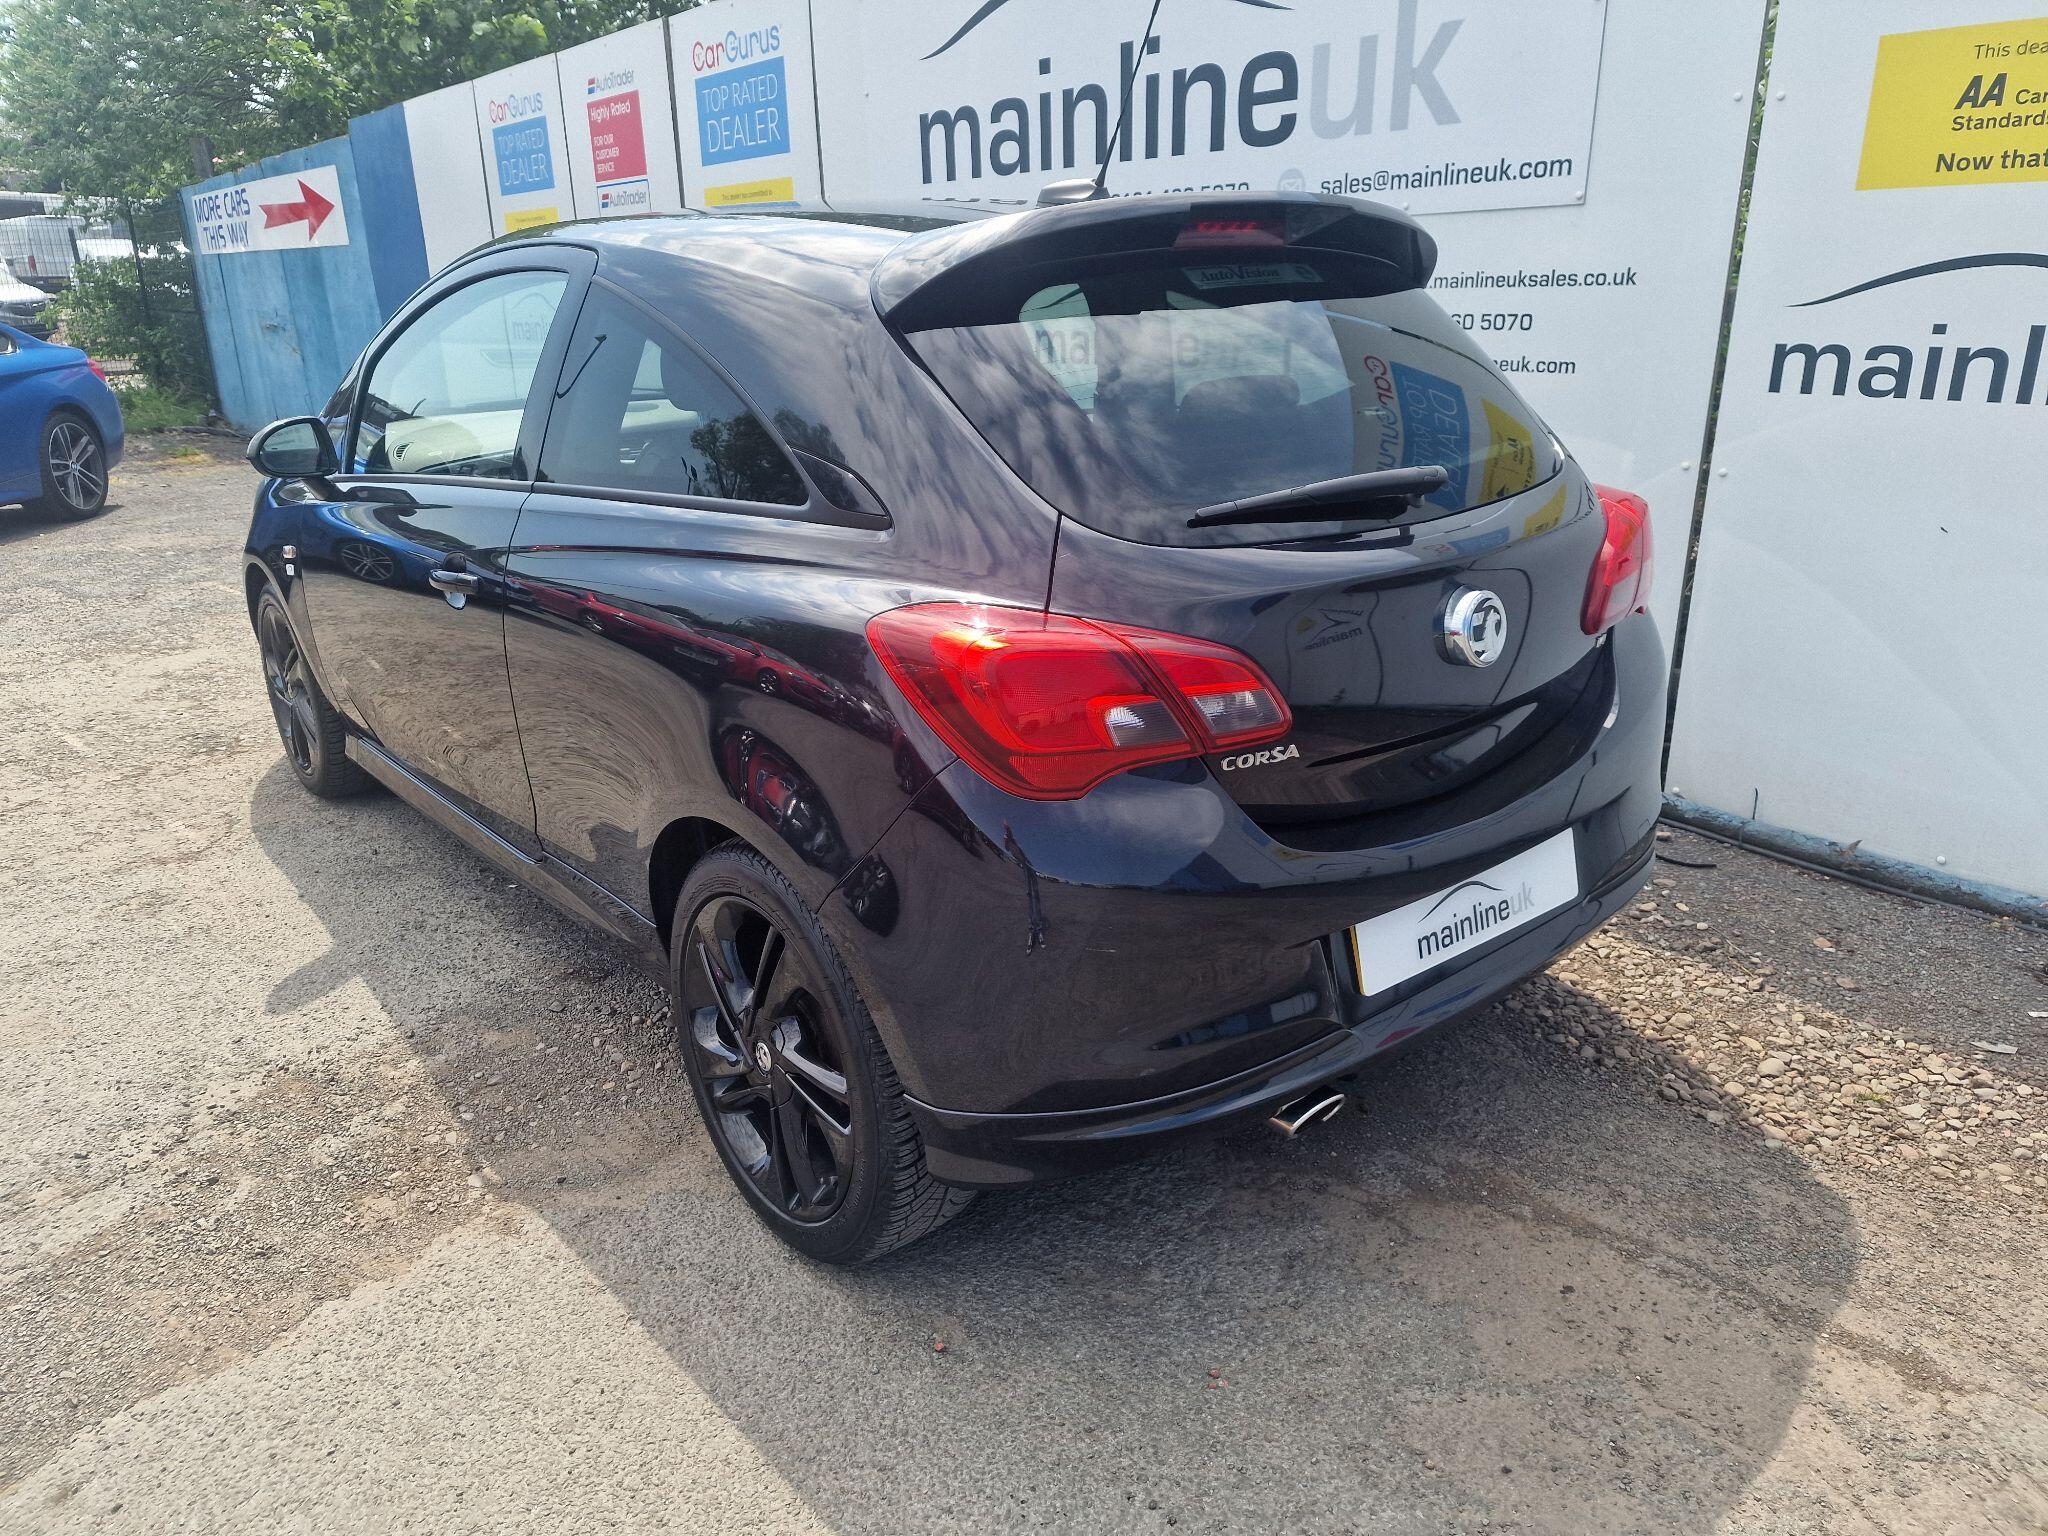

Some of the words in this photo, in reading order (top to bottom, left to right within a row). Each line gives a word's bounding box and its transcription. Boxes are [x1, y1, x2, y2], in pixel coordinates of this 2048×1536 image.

[692, 25, 780, 72] CarGurus
[1975, 42, 2011, 60] This
[2016, 40, 2048, 56] dea
[596, 69, 635, 92] AutoTrader
[702, 85, 729, 114] TOP
[733, 73, 778, 107] RATED
[1954, 73, 2008, 109] AA
[2015, 88, 2048, 105] Car
[488, 92, 543, 124] CarGurus
[590, 105, 610, 124] Highly
[610, 99, 631, 117] Rated
[498, 136, 514, 155] TOP
[515, 128, 544, 151] RATED
[707, 107, 781, 153] DEALER
[501, 153, 550, 186] DEALER
[1321, 157, 1573, 196] sales@mainlineuk.com
[1935, 153, 1994, 173] Now
[194, 194, 223, 223] MORE
[223, 188, 251, 218] CARS
[610, 190, 647, 207] AutoTrader
[203, 224, 227, 251] THIS
[226, 220, 249, 248] WAY
[1480, 313, 1533, 331] 5070
[1767, 323, 2048, 406] mainl
[1220, 744, 1301, 771] CORSA
[1416, 881, 1536, 960] mainlineuk
